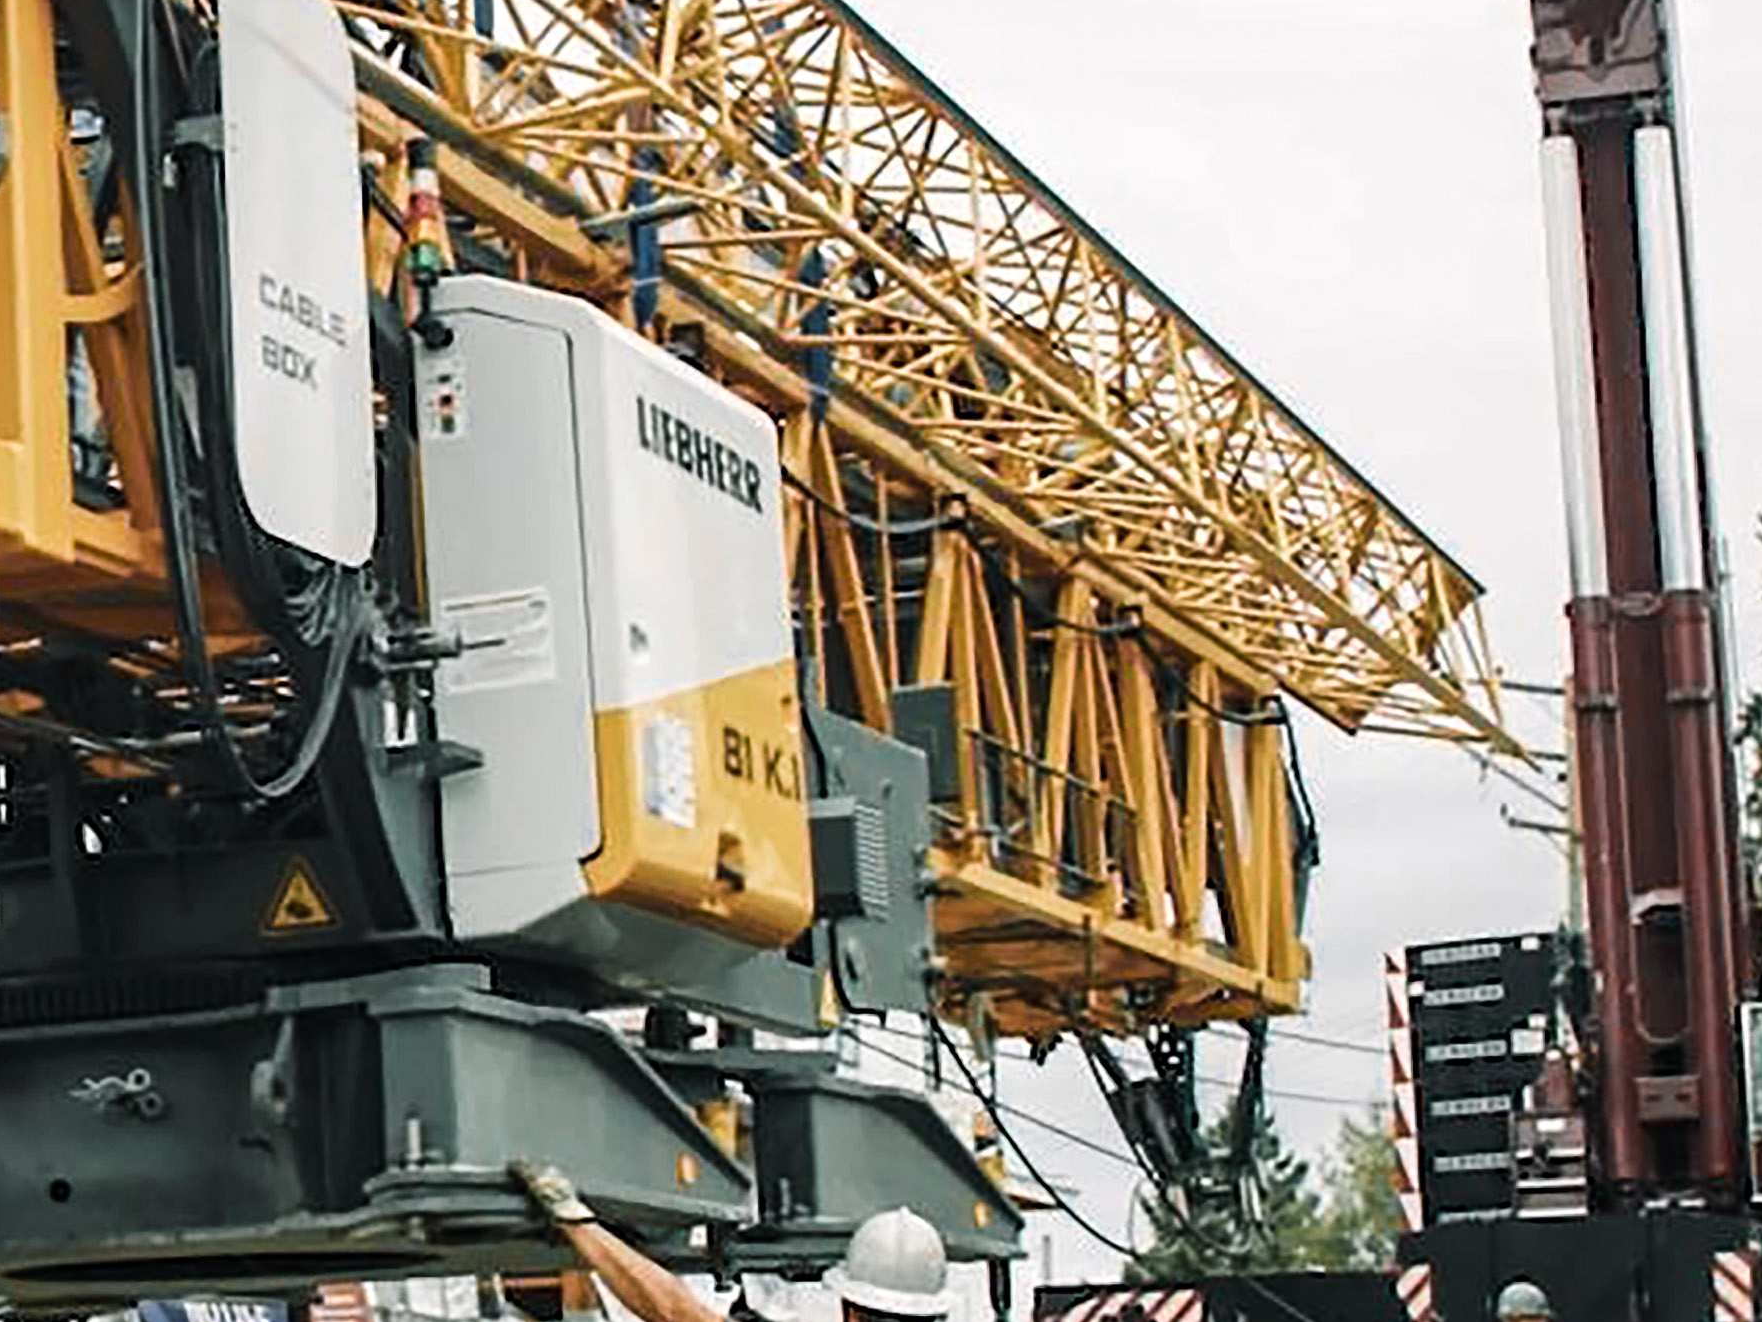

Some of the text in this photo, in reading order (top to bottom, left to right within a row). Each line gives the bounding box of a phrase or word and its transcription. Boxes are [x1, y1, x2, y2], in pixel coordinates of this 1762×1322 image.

[259, 272, 348, 348] CABLE
[261, 334, 318, 392] BOX
[637, 395, 764, 514] LIEBHERR
